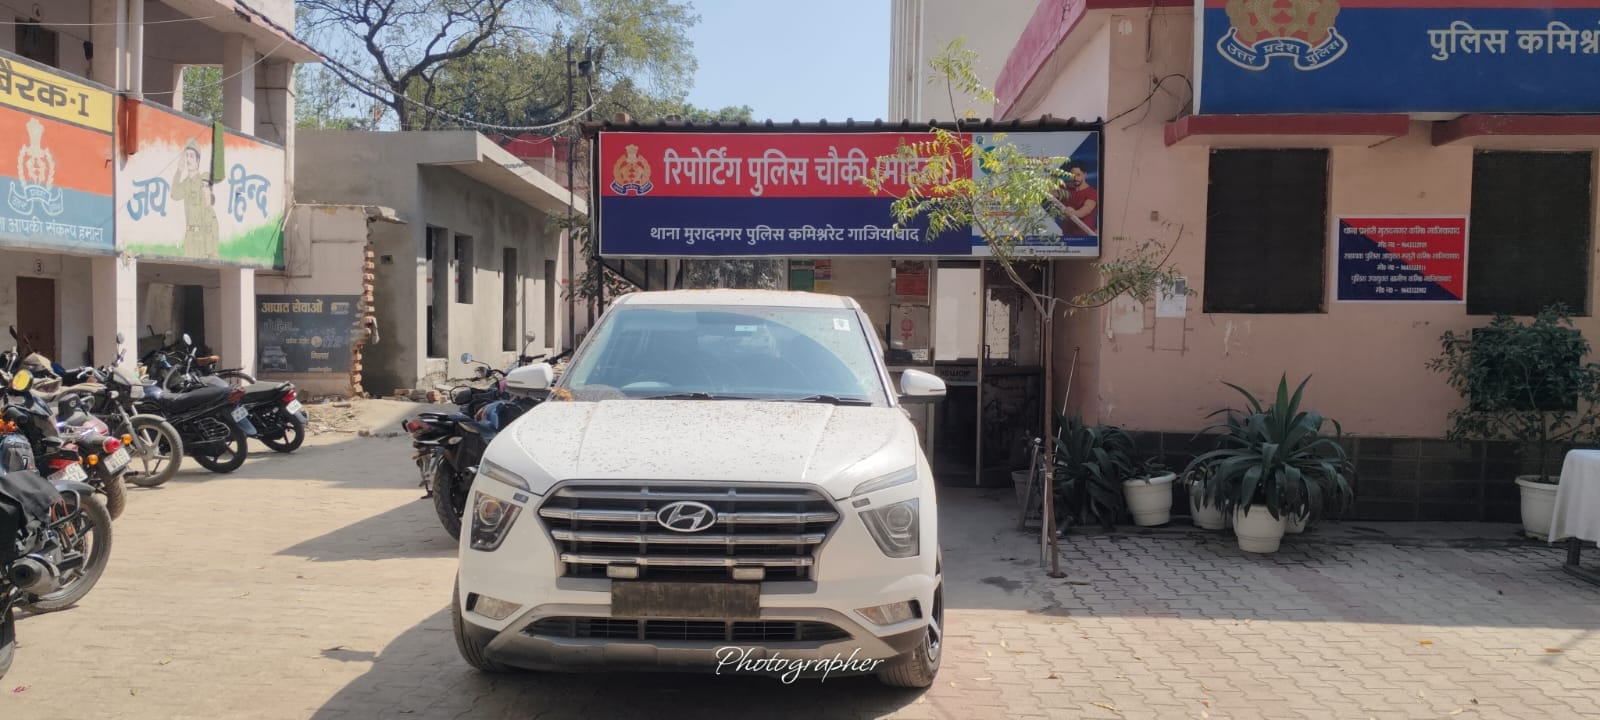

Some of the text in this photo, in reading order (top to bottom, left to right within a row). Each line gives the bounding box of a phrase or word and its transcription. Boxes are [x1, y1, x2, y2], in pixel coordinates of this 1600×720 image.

[1226, 40, 1340, 66] उत्तर प्रदेश पुलिस
[1428, 21, 1508, 60] पुलिस
[664, 147, 742, 185] रिपोर्टिंग
[748, 149, 809, 197] पुलिस
[814, 146, 869, 185] चौकी
[127, 163, 271, 222] जय हिन्द
[8, 216, 42, 233] आपकी
[45, 219, 77, 239] संकल्प
[651, 227, 681, 240] थाना
[685, 227, 743, 245] मुरादनगर
[746, 225, 785, 246] पुलिस
[848, 224, 920, 242] गाजियाबाद
